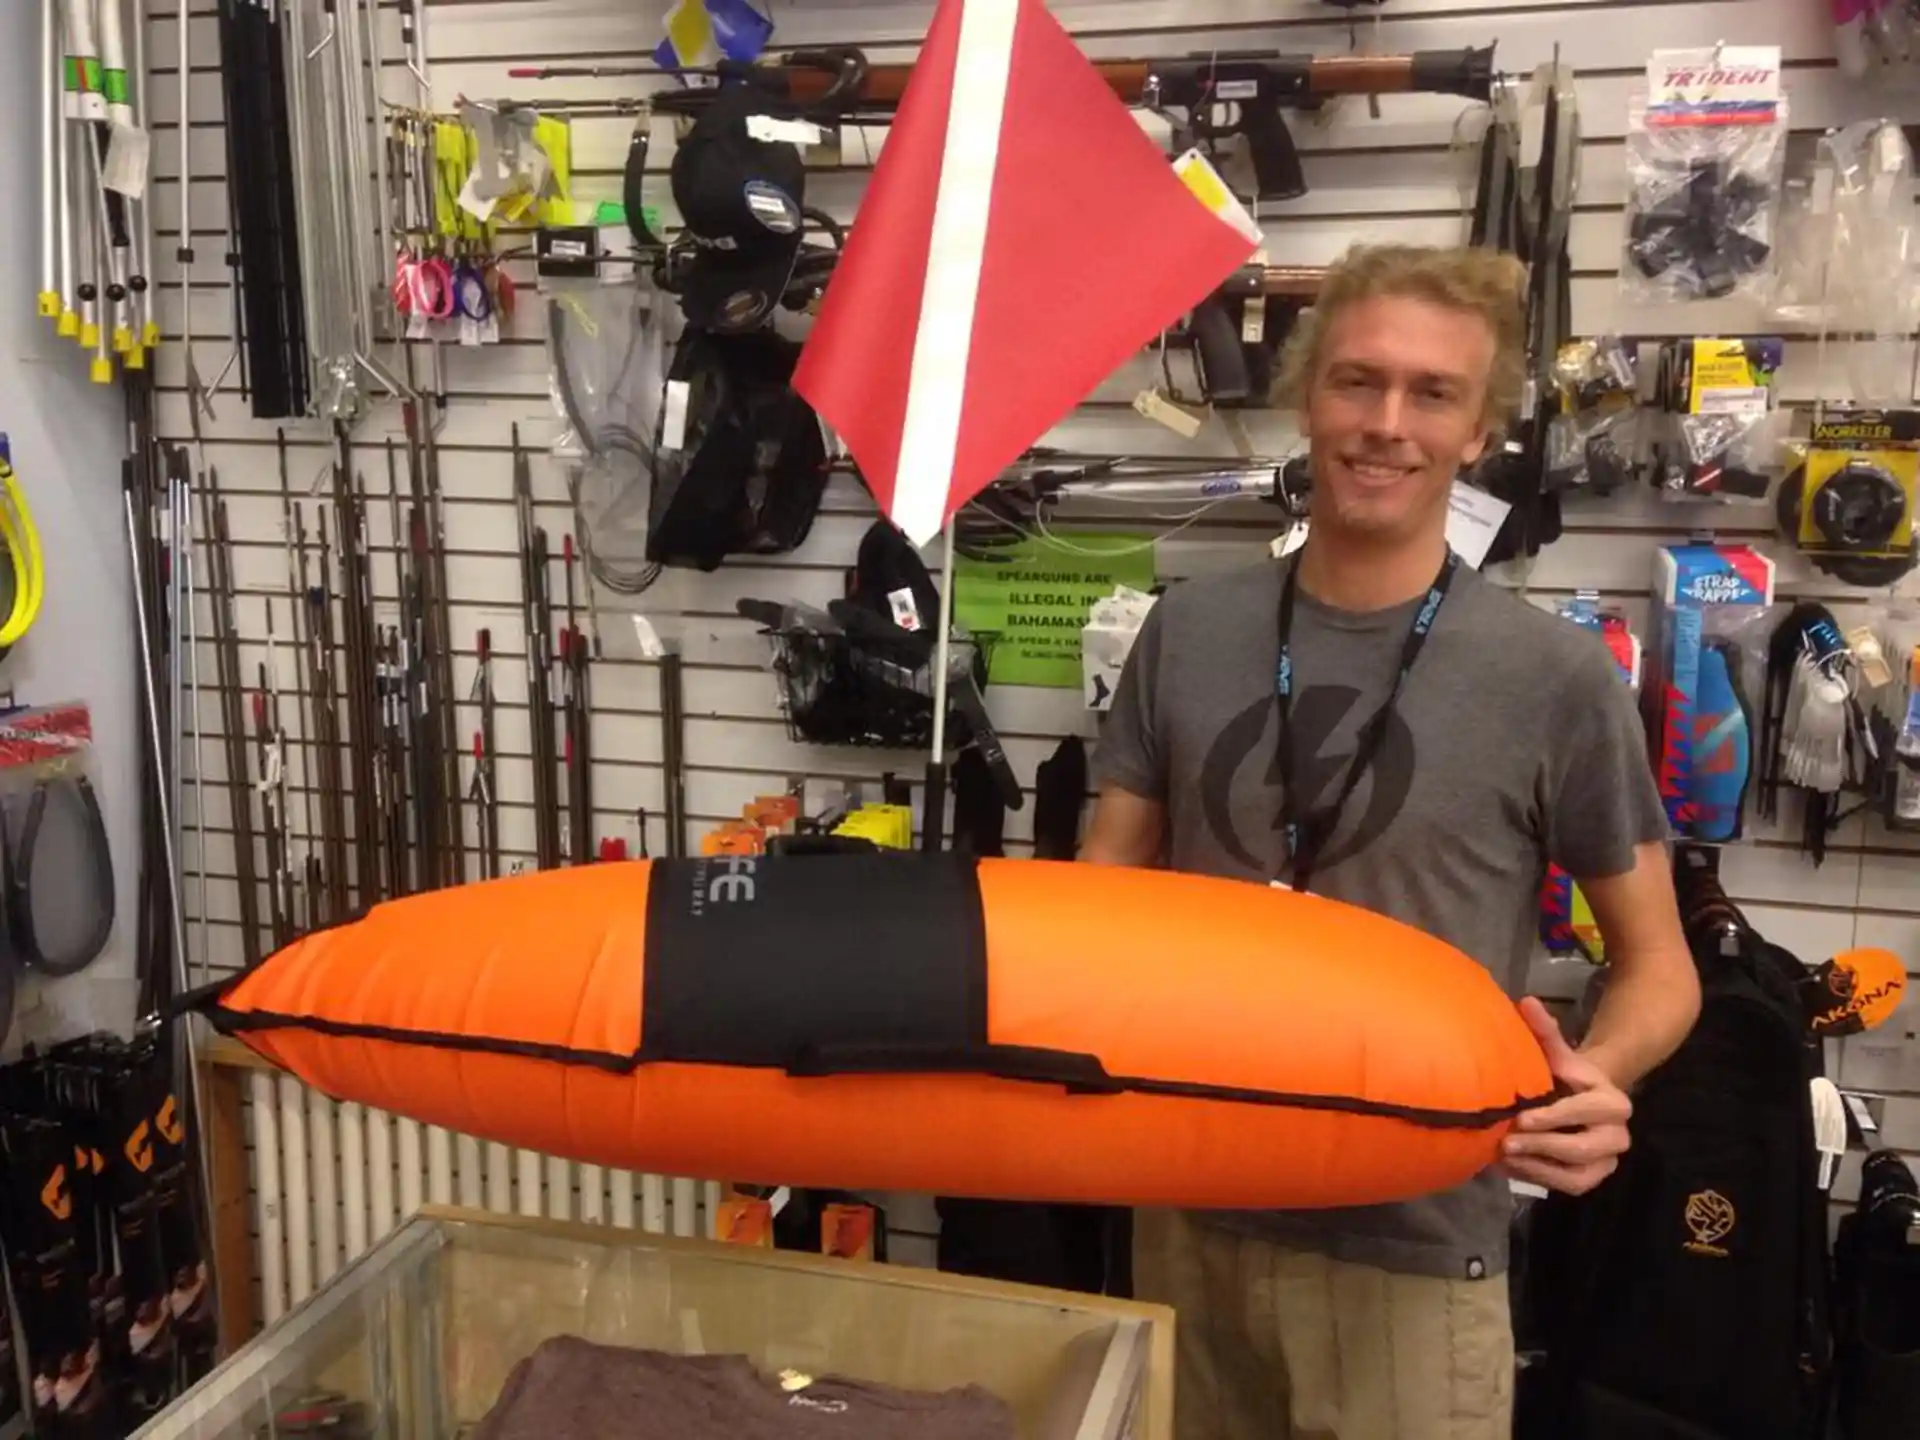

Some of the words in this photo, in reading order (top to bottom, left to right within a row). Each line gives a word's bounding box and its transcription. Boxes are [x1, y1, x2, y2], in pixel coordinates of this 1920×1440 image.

[1663, 69, 1776, 87] TRIDENT
[997, 570, 1081, 584] SPEARGUNS
[1085, 573, 1112, 584] ARE
[1694, 574, 1740, 590] STRAP
[1008, 592, 1075, 607] ILLEGAL
[1081, 595, 1099, 608] IN
[1811, 981, 1902, 1029] AKONA
